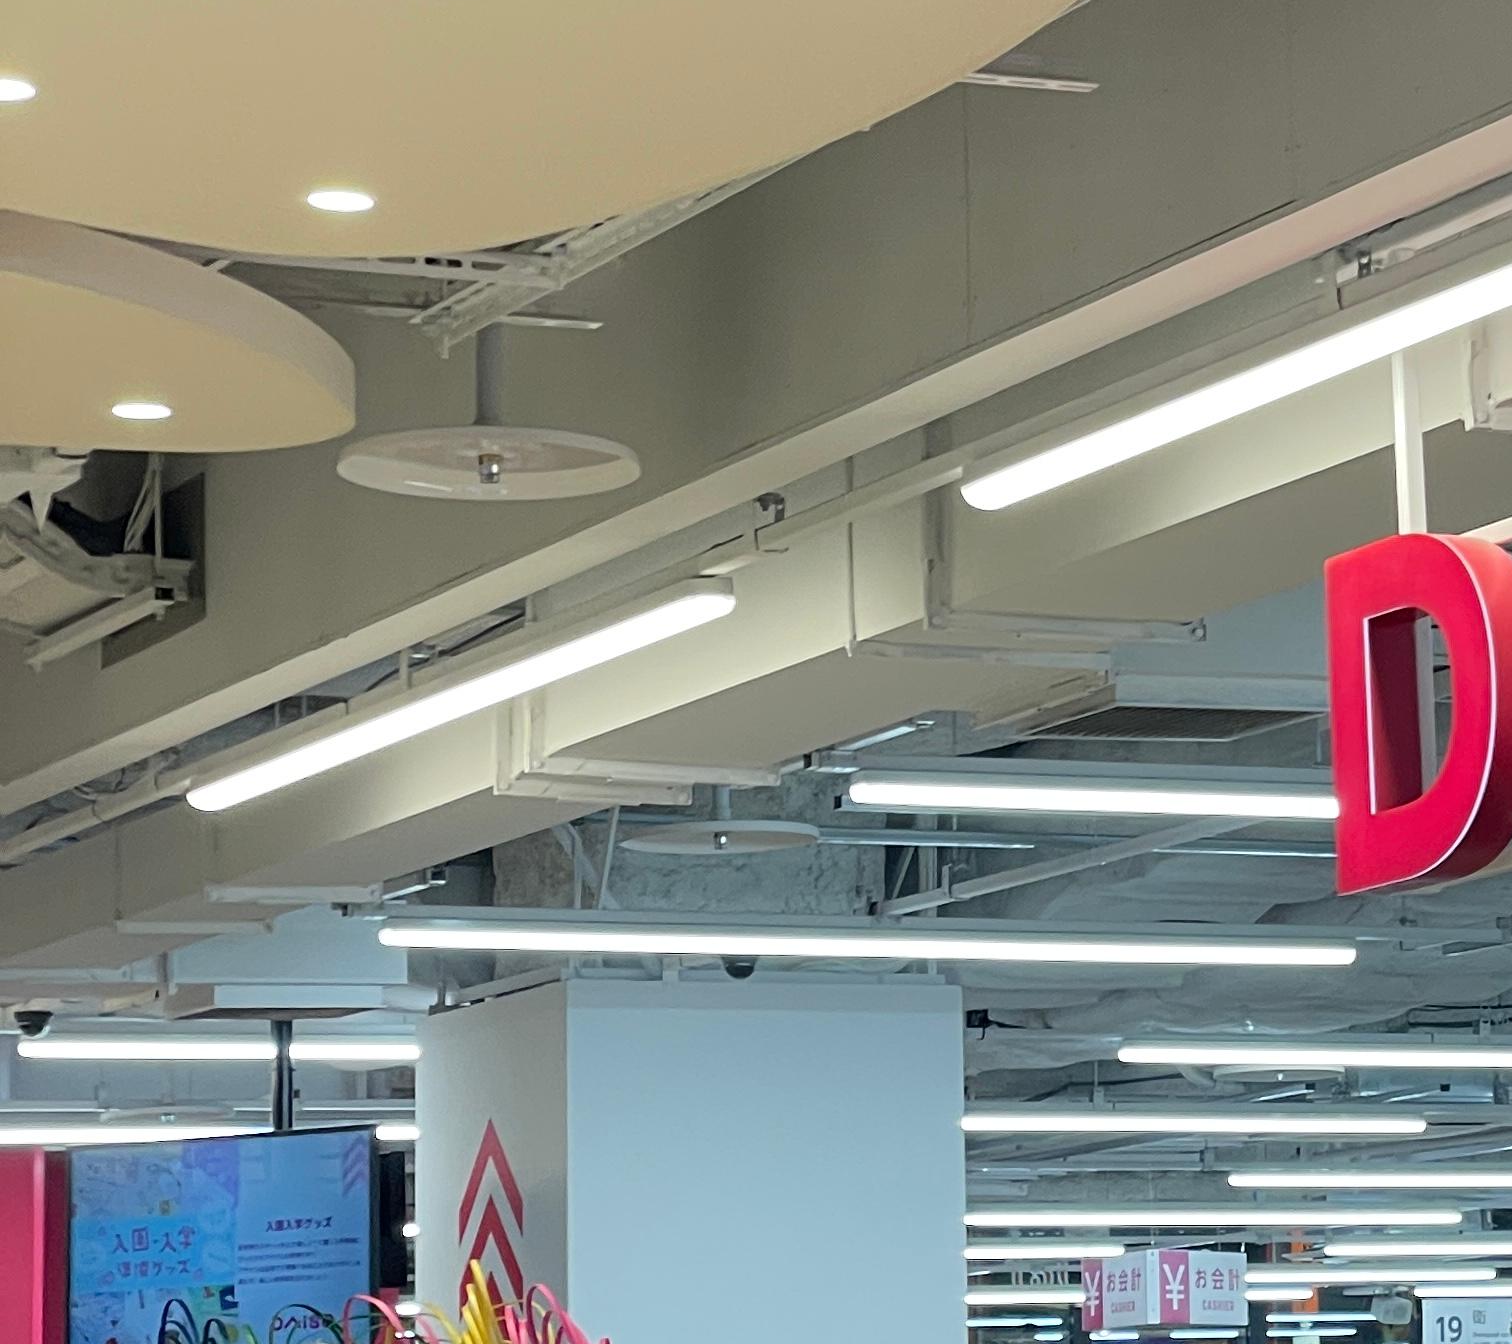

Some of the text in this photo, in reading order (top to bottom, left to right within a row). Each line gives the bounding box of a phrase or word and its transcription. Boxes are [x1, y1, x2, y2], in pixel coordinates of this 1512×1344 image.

[1106, 1267, 1142, 1293] お会計
[1194, 1267, 1240, 1292] お会計
[1436, 1315, 1463, 1343] 19
